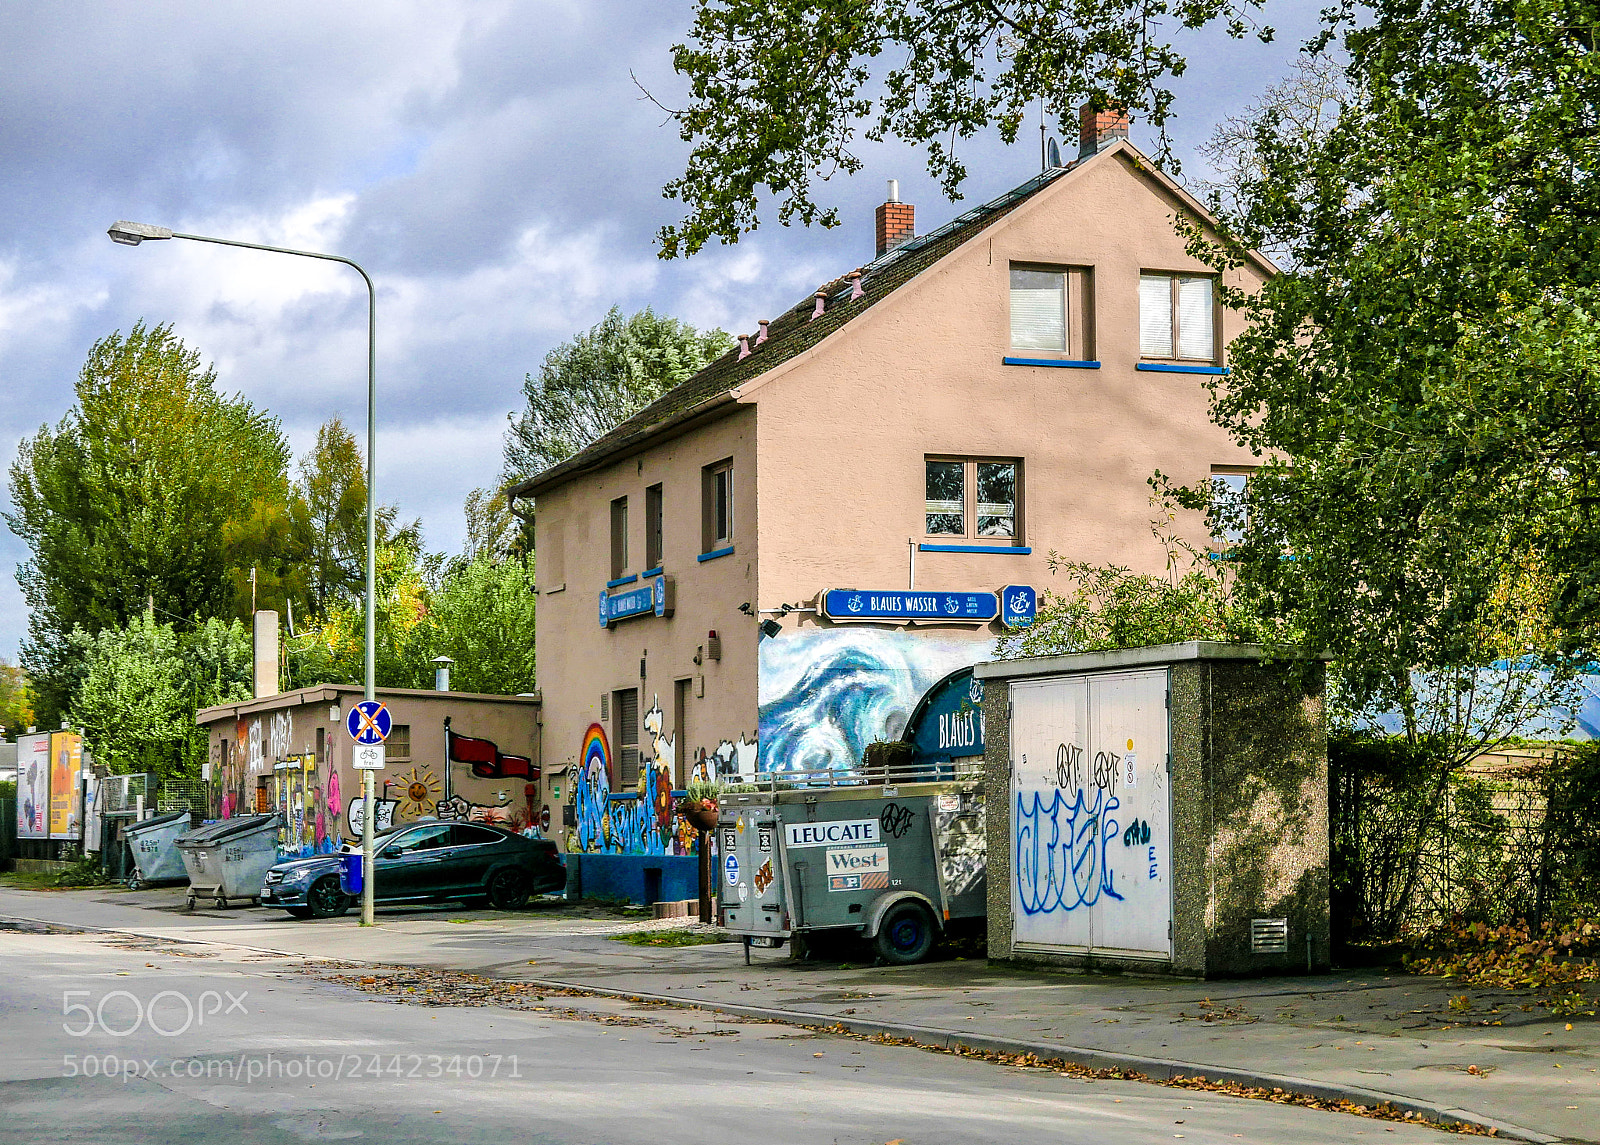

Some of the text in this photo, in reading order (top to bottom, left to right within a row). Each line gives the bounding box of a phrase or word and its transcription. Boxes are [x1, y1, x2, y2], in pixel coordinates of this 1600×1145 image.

[871, 596, 938, 613] BLAUES WASSER
[939, 710, 975, 749] BLAUES
[792, 823, 873, 844] LEUCATE
[830, 852, 880, 869] West
